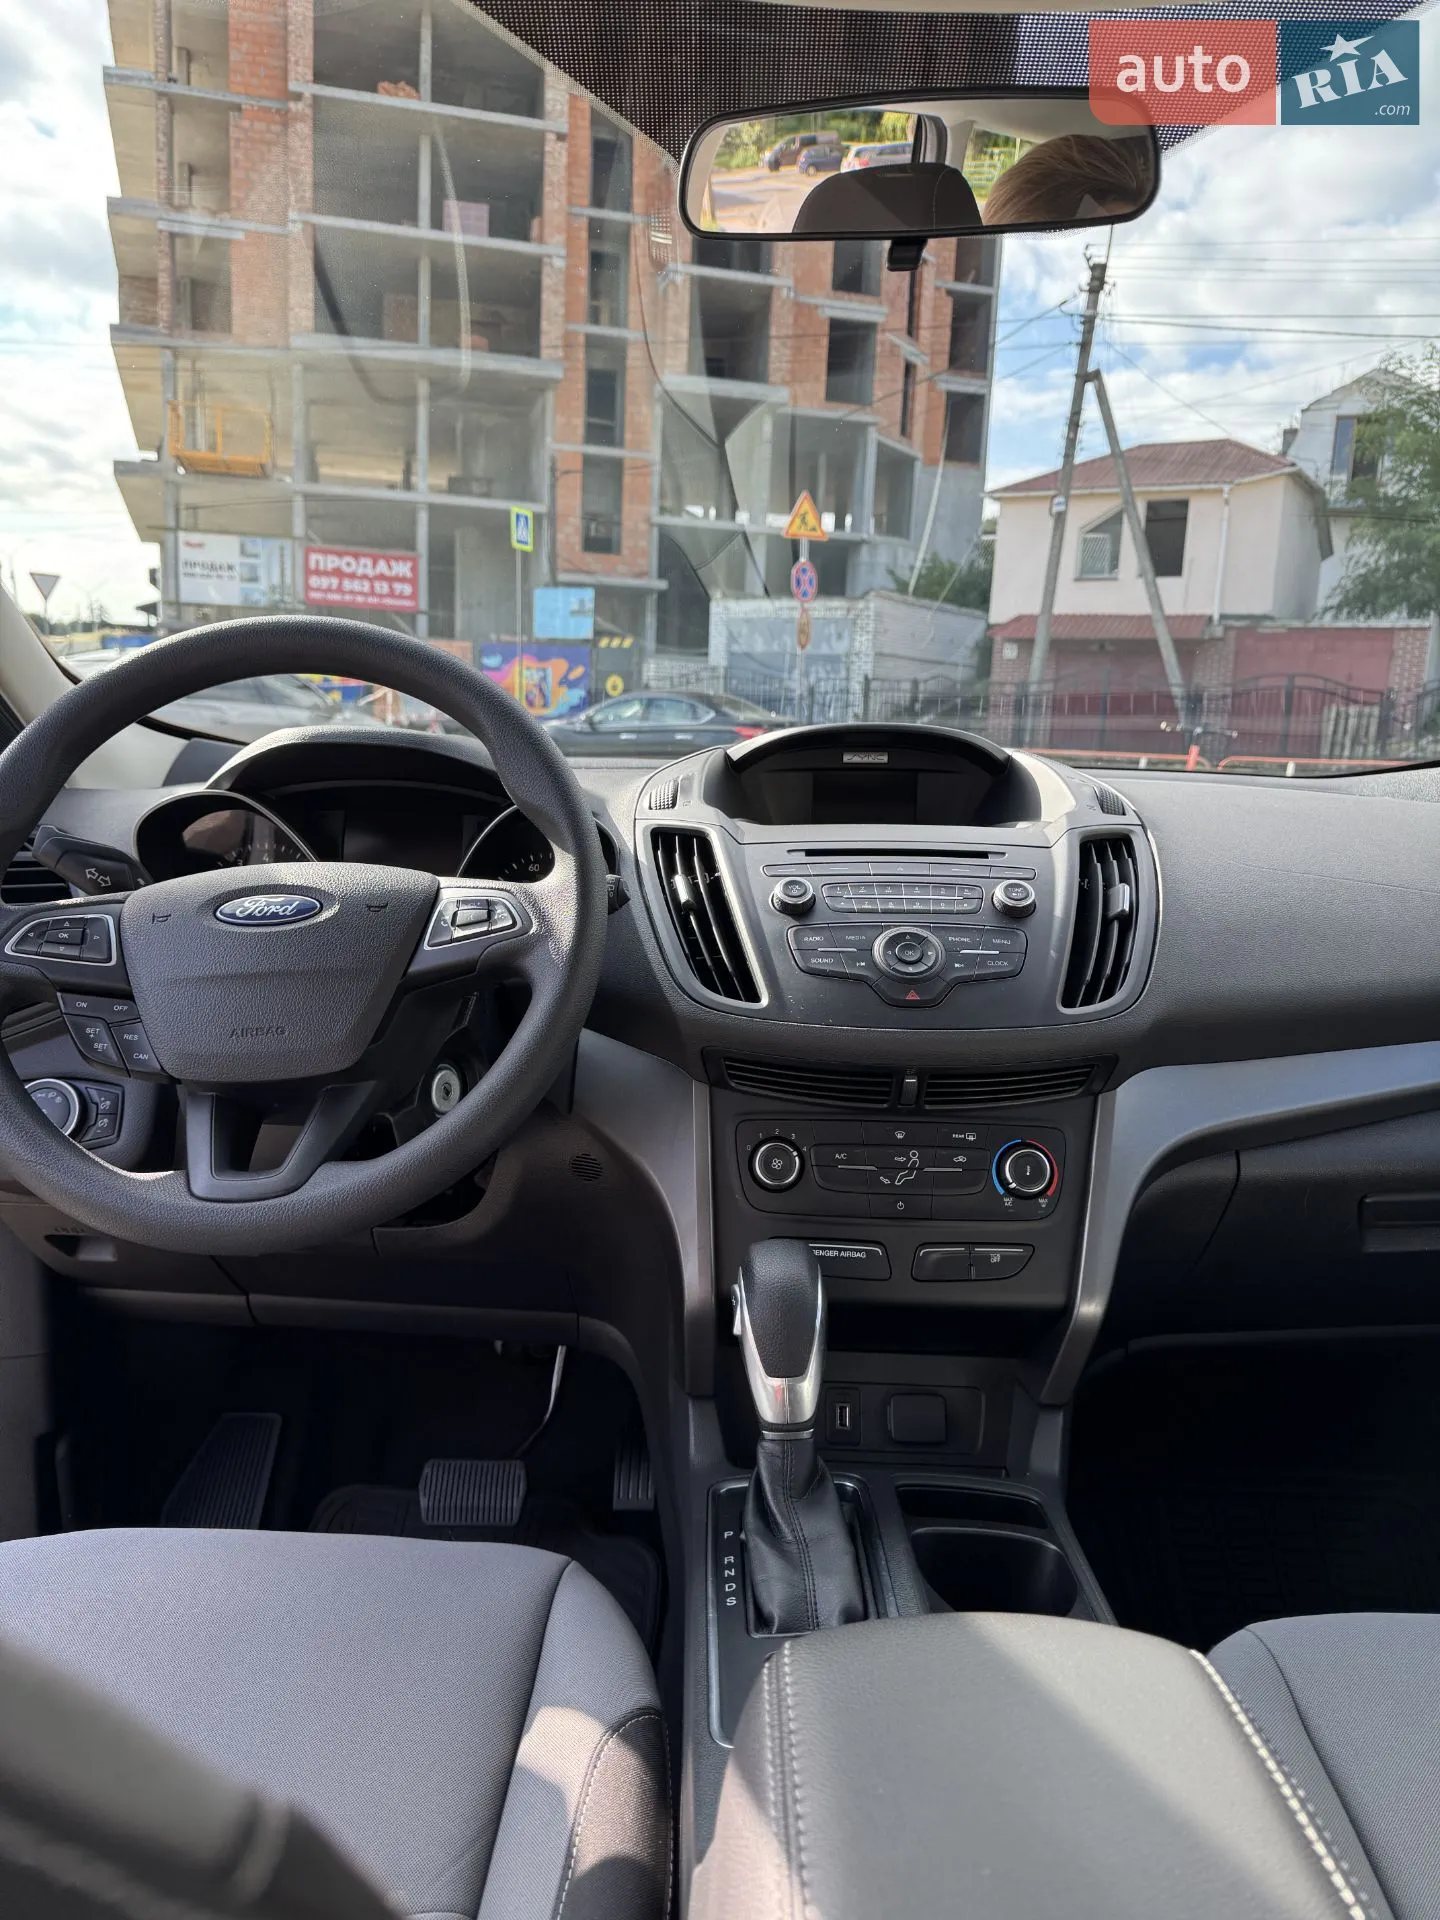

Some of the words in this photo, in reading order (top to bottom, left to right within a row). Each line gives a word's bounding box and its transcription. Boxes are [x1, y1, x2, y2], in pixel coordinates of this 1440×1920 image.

[308, 552, 414, 579] ПРОДАЖ
[528, 863, 540, 872] 60
[236, 897, 298, 917] Ford
[123, 1033, 139, 1041] RES
[229, 1025, 286, 1040] AIRBAG
[840, 1250, 866, 1259] AIRBAG
[723, 1530, 734, 1539] P
[724, 1555, 735, 1565] R
[724, 1568, 735, 1578] N
[725, 1583, 736, 1592] D
[726, 1596, 737, 1606] S
